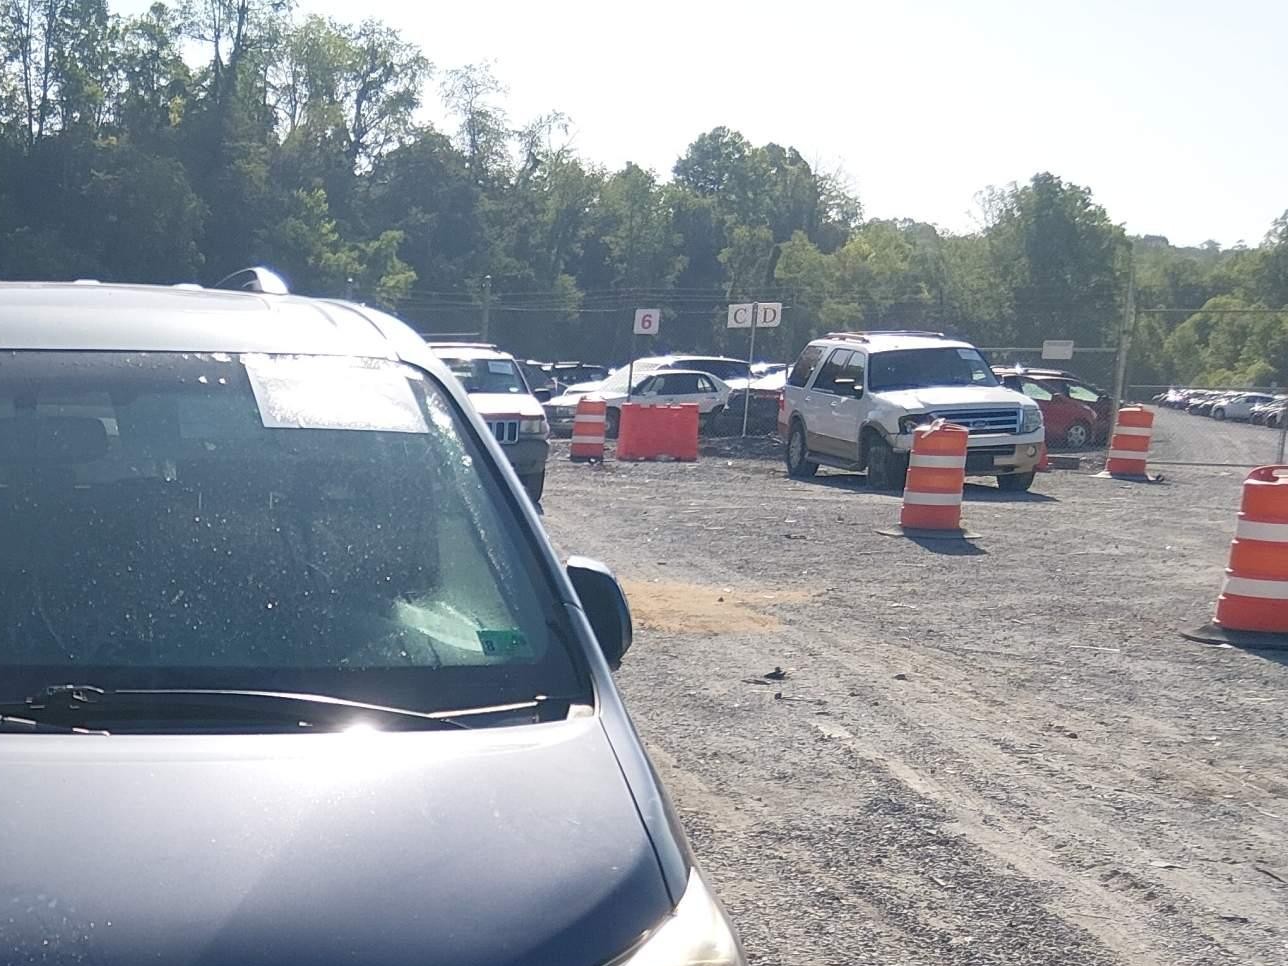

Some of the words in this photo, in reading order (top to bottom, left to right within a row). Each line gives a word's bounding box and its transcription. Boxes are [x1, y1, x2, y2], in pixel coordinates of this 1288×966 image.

[641, 314, 652, 330] 6
[733, 308, 747, 324] C
[762, 307, 777, 324] D
